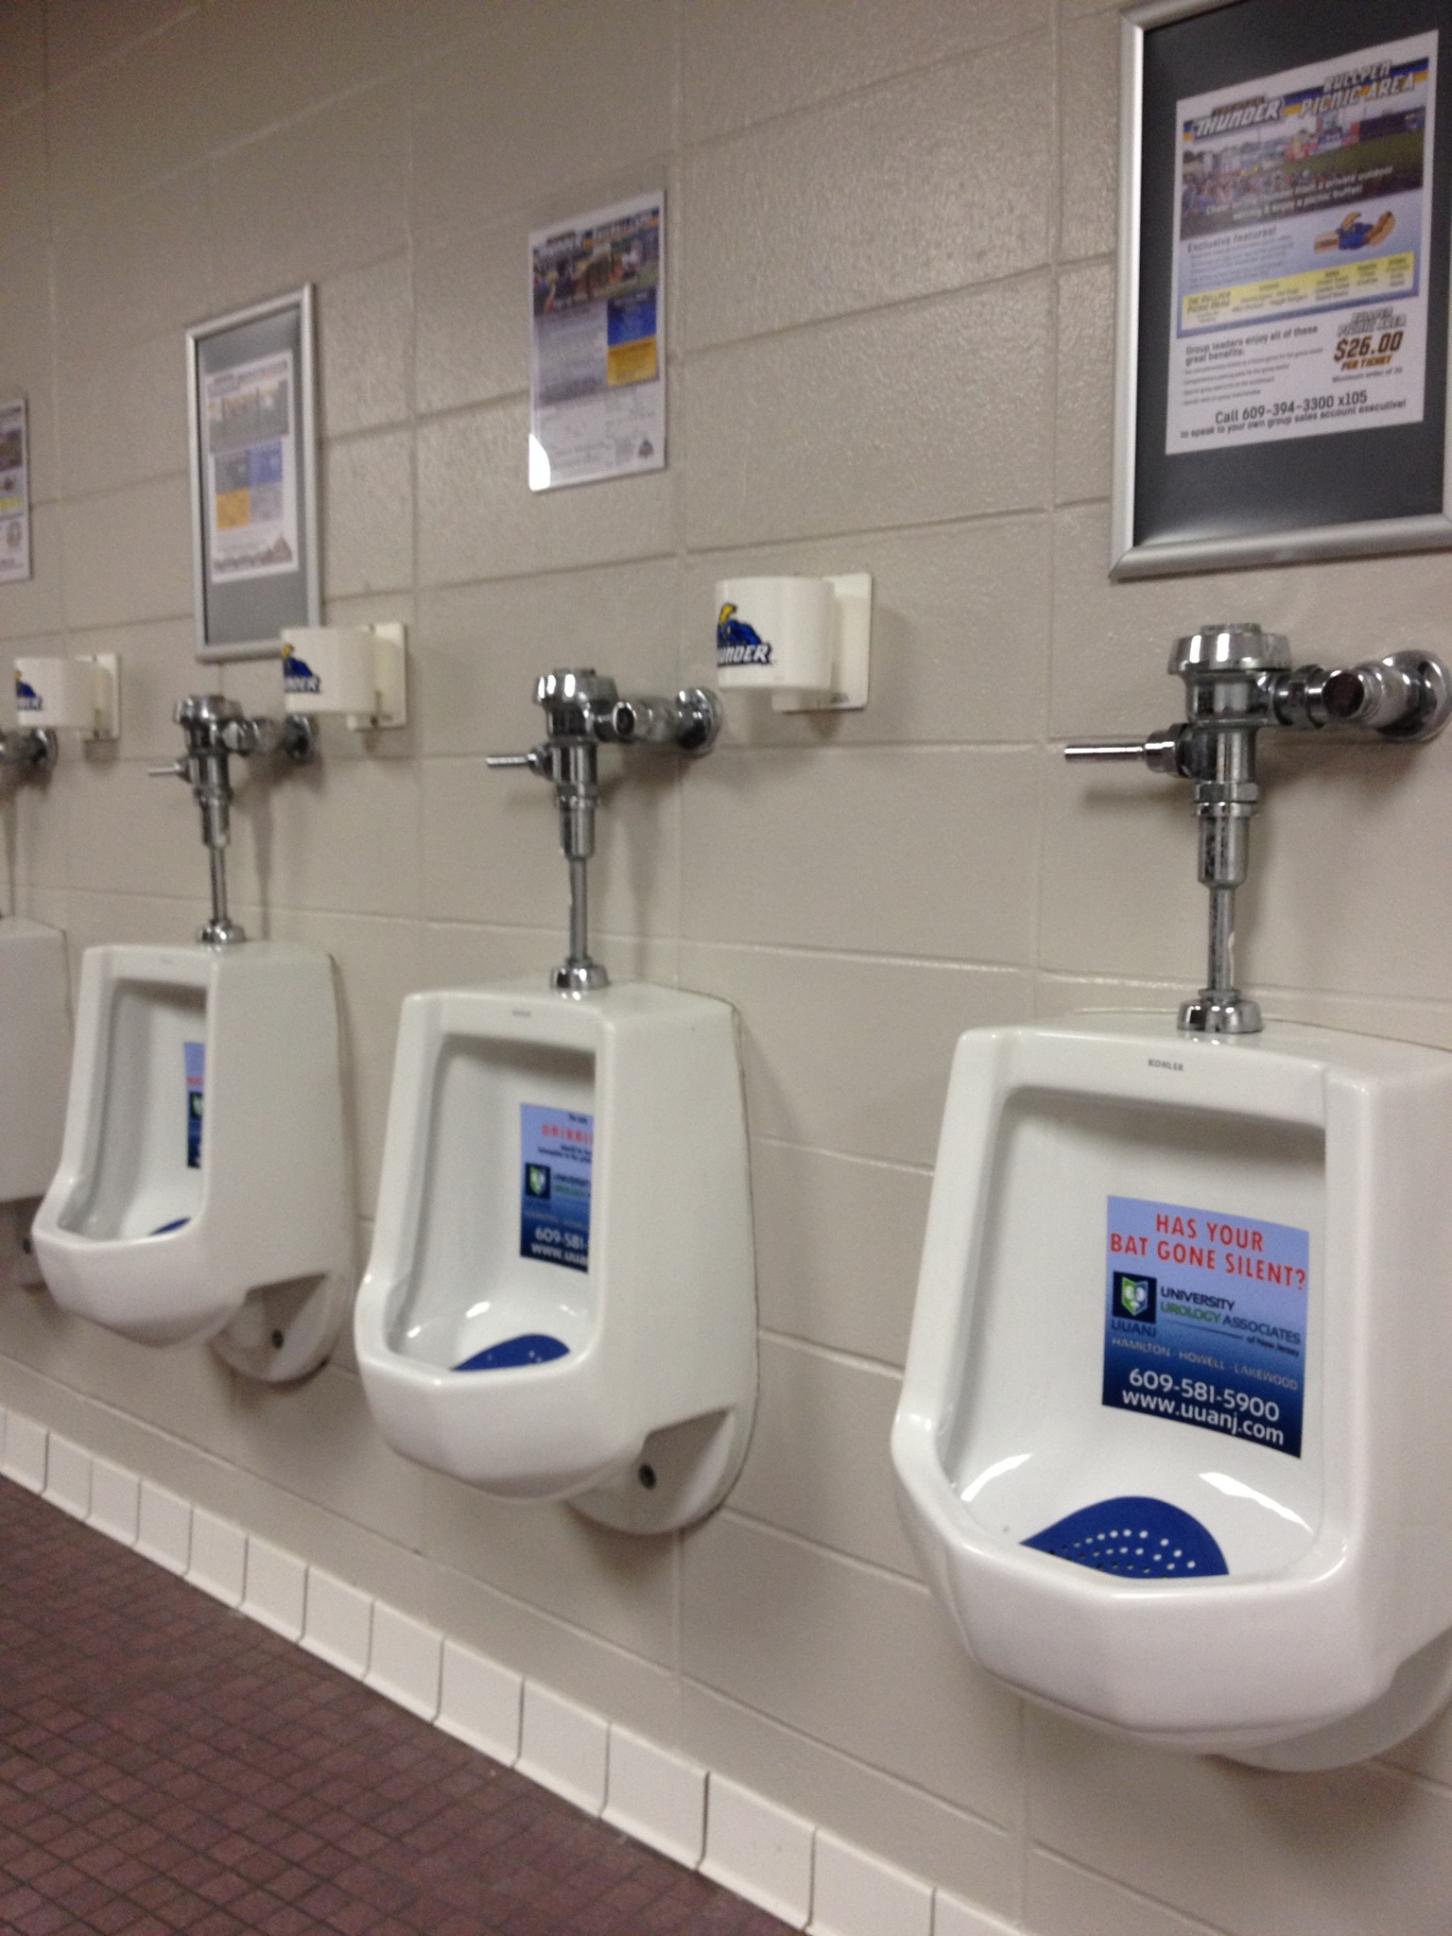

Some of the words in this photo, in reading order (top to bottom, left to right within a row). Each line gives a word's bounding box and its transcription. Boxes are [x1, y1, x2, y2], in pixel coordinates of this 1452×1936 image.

[1298, 84, 1363, 117] PICNIC
[1367, 70, 1415, 99] AREA
[1195, 99, 1282, 137] THUNDER
[1245, 334, 1268, 346] enjoy
[1283, 327, 1292, 338] of
[1294, 325, 1318, 337] these
[1334, 330, 1404, 362] $26.00
[1215, 409, 1239, 424] Call
[1242, 395, 1334, 421] 609-394-3300
[1338, 389, 1367, 407] x105
[1227, 423, 1245, 434] your
[1247, 420, 1265, 429] own
[1267, 416, 1292, 429] group
[1294, 412, 1317, 422] sales
[1320, 407, 1356, 419] account
[1358, 398, 1406, 414] executive!
[1156, 1213, 1197, 1239] HAS
[1207, 1222, 1264, 1251] YOUR
[1110, 1232, 1148, 1256] BAT
[1157, 1241, 1215, 1270] GONE
[1225, 1252, 1306, 1290] SILENT?
[1161, 1286, 1235, 1311] UNIVERSITY
[1111, 1319, 1156, 1338] UUANJ
[1161, 1302, 1221, 1324] UROLOGY
[1222, 1314, 1301, 1345] ASSOCIATES
[1112, 1337, 1170, 1358] HAMILTON
[1178, 1350, 1225, 1371] HOWELL
[1234, 1364, 1297, 1391] LAKEWOOD
[1129, 1368, 1280, 1422] 609-581-5900
[1122, 1389, 1284, 1446] www.uuanj.com
